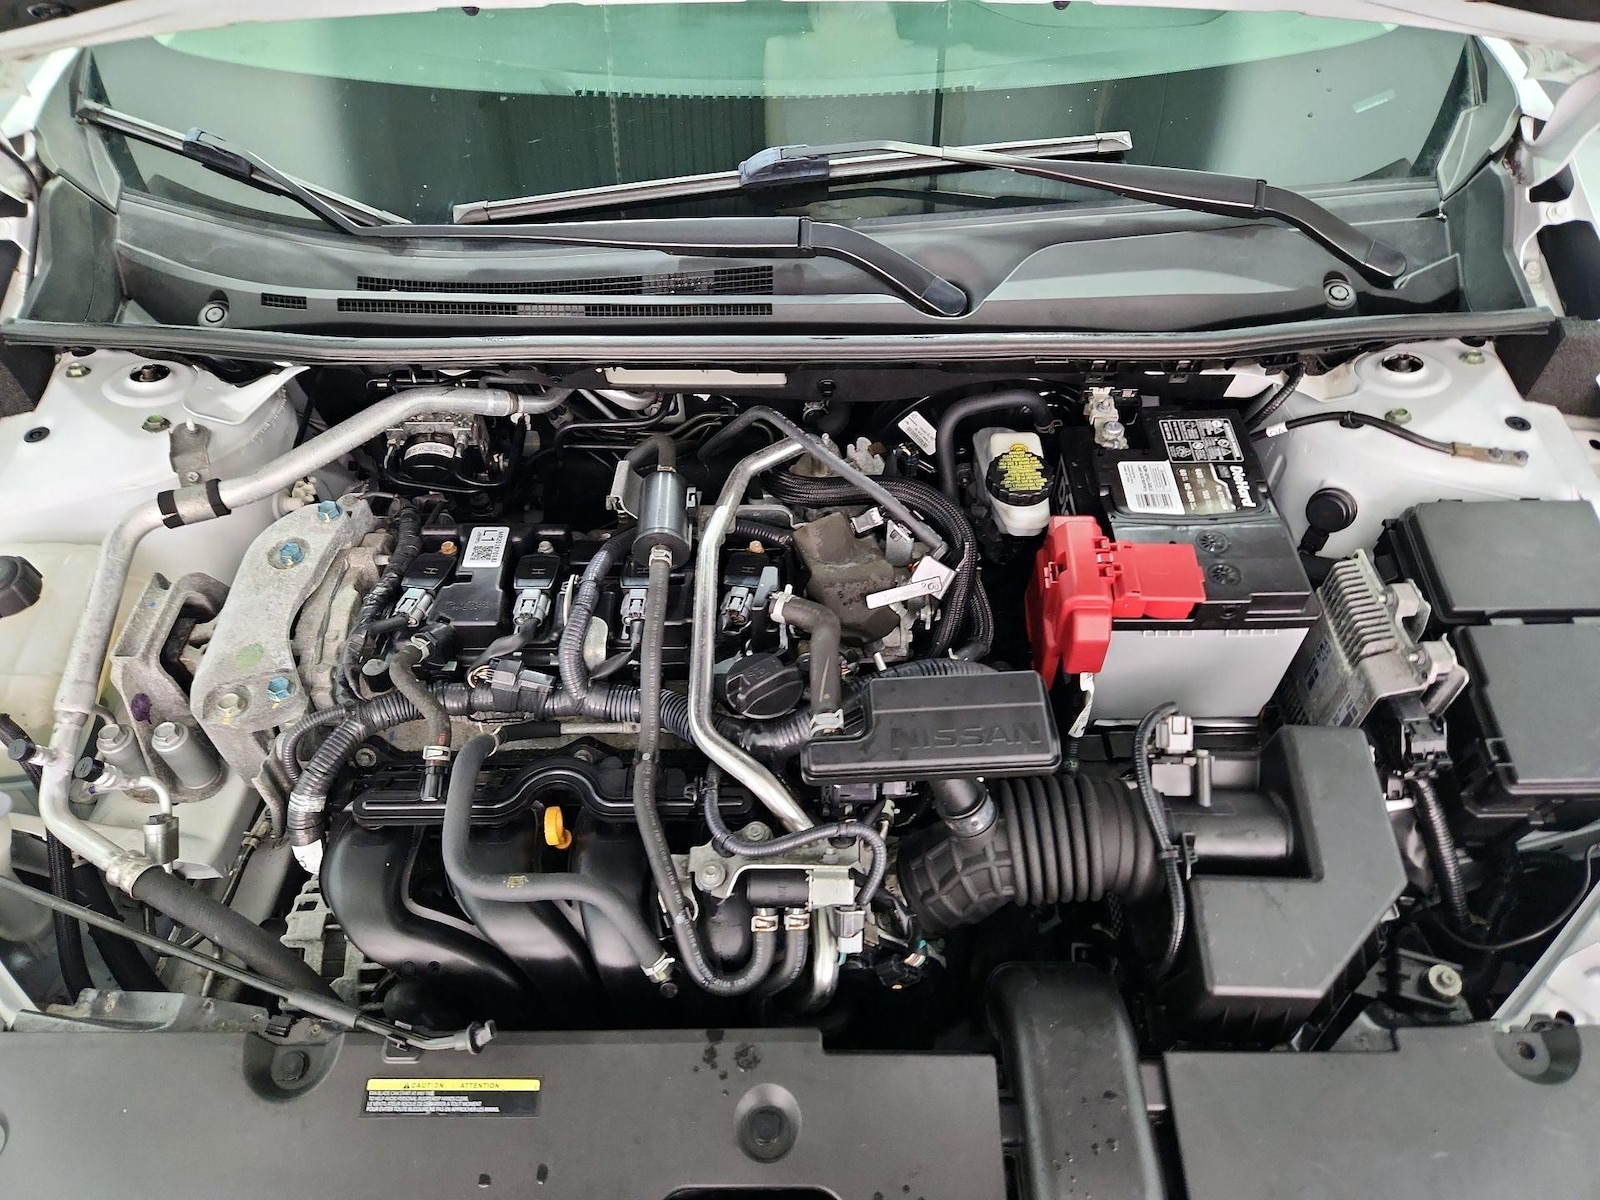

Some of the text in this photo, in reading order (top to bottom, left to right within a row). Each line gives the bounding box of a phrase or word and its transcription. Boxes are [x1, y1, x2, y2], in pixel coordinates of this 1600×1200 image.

[1230, 466, 1257, 507] DieHard
[481, 530, 498, 541] L1
[890, 723, 1041, 751] NISSAN
